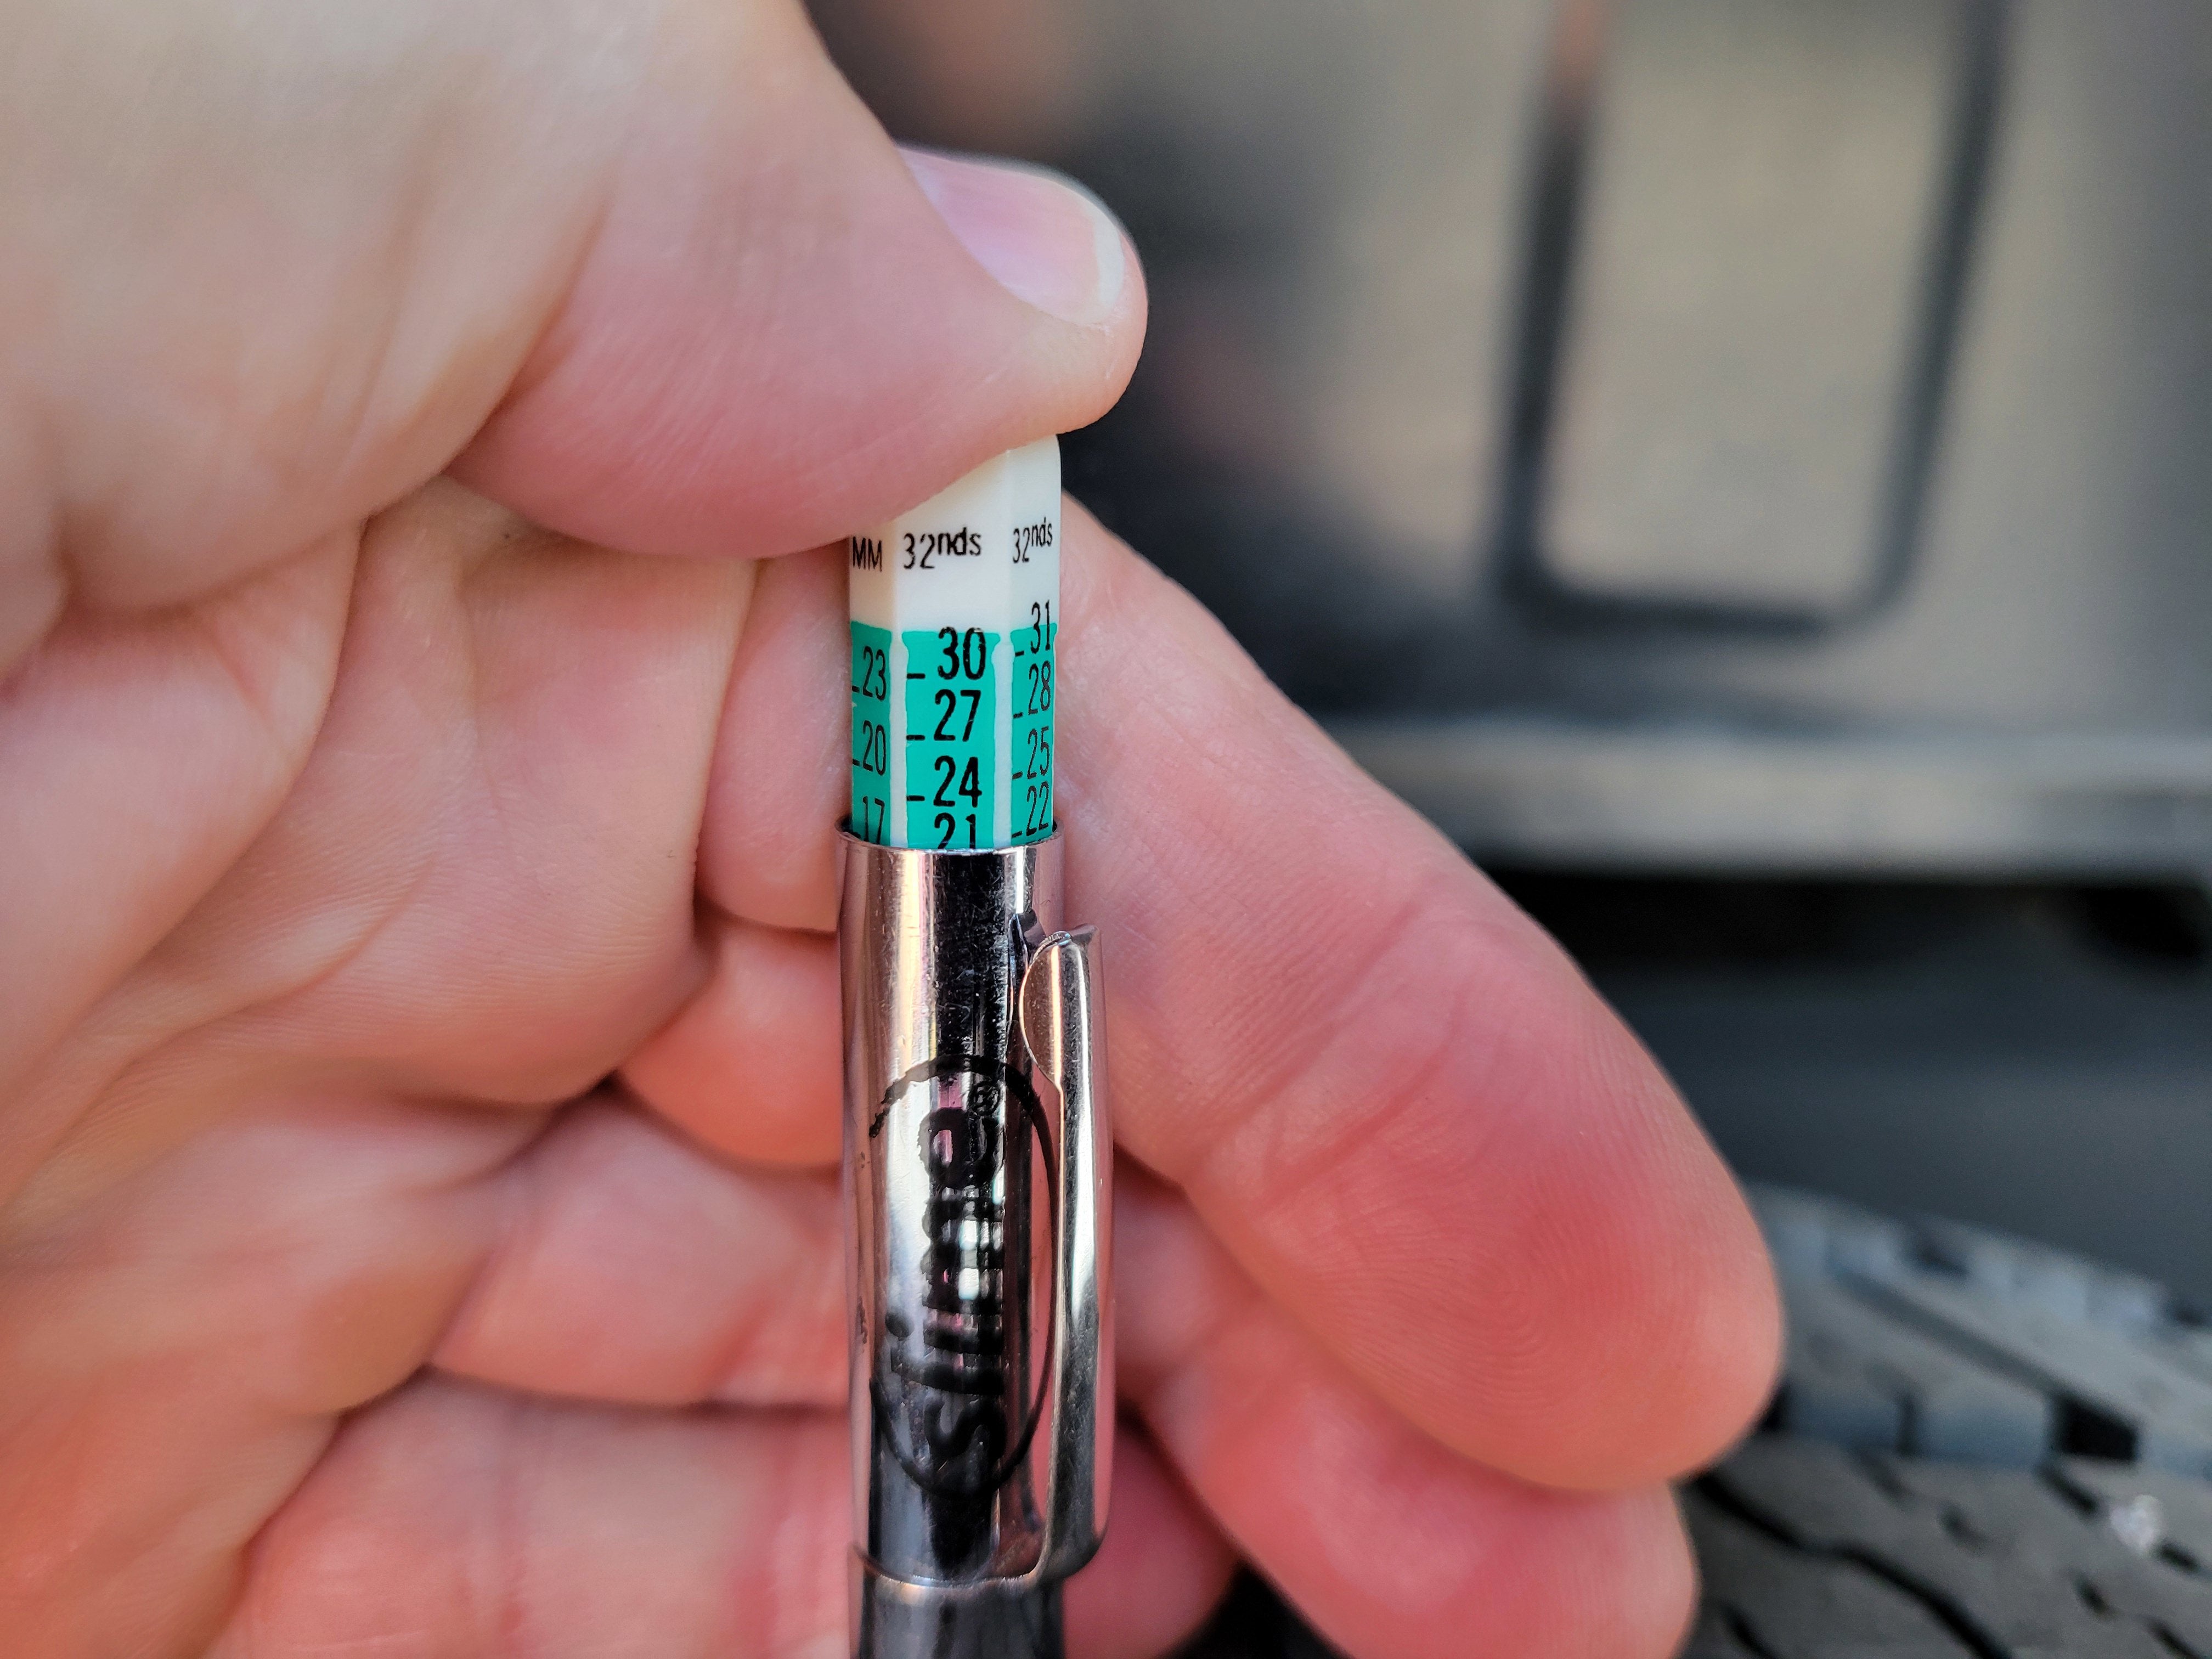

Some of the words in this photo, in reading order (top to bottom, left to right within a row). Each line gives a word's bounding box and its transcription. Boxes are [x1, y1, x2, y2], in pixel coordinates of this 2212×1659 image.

[852, 536, 882, 571] MM
[904, 527, 981, 569] 32nds
[1013, 517, 1052, 563] 32nds
[938, 627, 986, 680] 30
[1030, 600, 1050, 654] 31
[863, 646, 887, 701] 23
[1028, 661, 1051, 714] 28
[934, 689, 981, 742] 27
[863, 720, 887, 775] 20
[1027, 726, 1049, 779] 25
[933, 755, 982, 808] 24
[863, 795, 885, 844] 17
[934, 812, 976, 849] 21
[1026, 781, 1049, 836] 22
